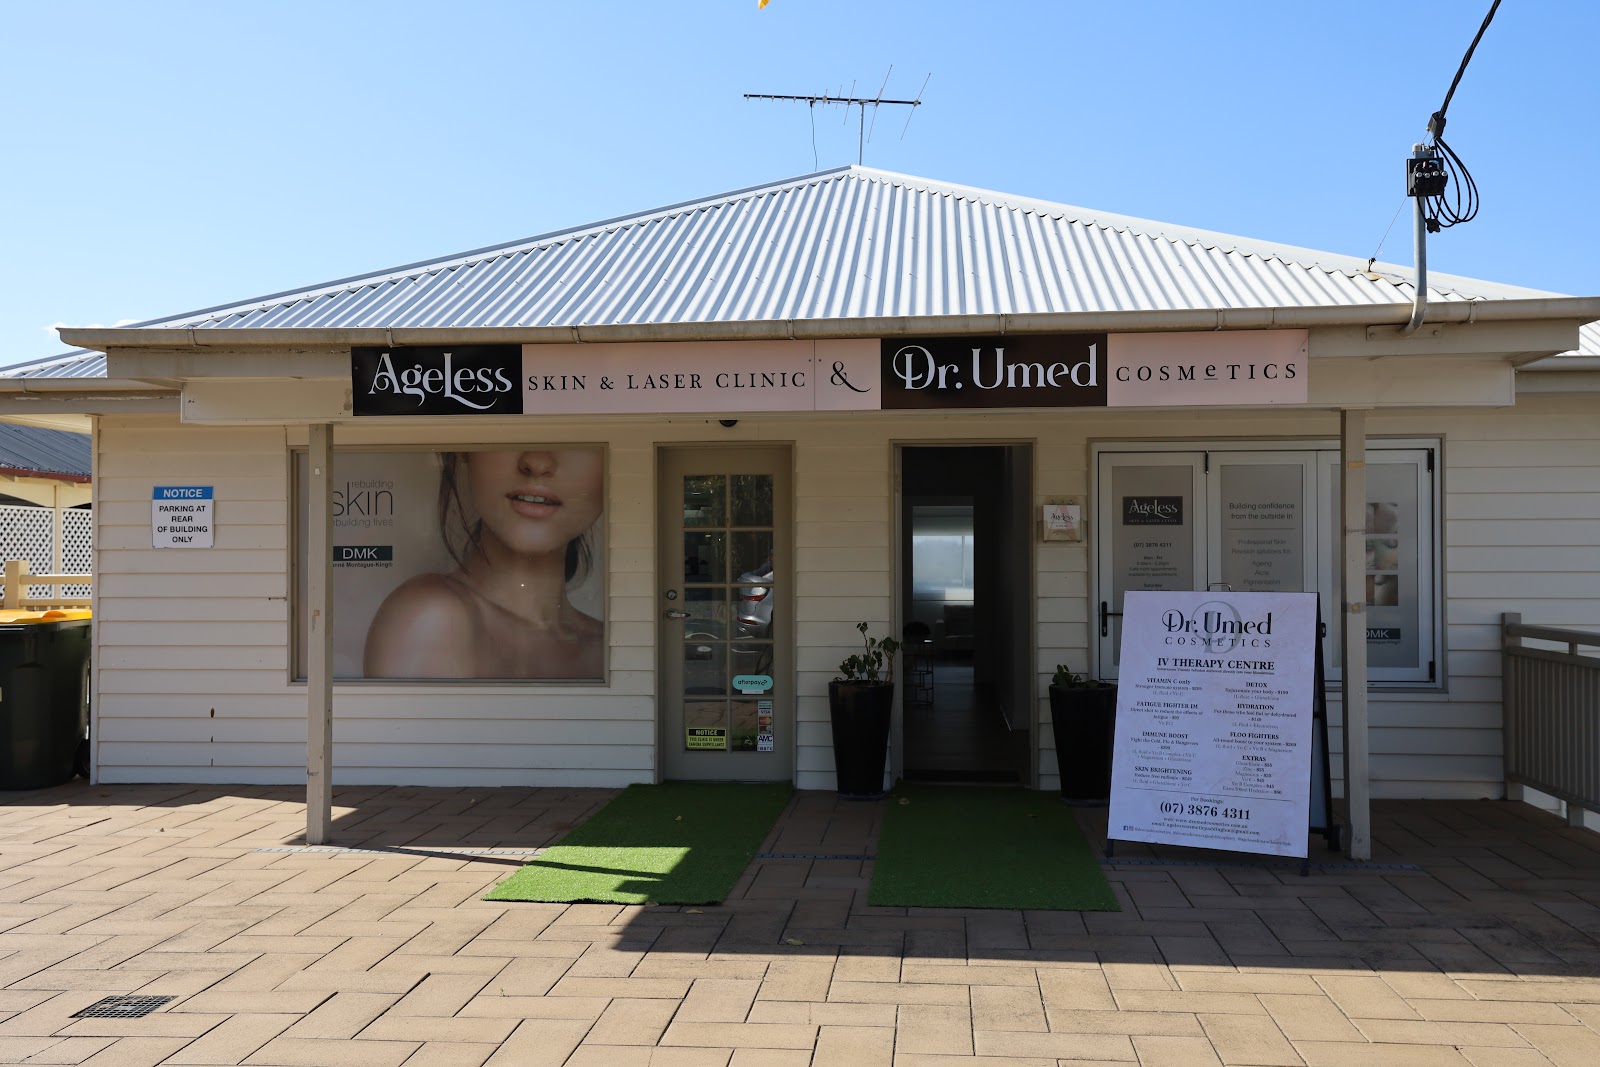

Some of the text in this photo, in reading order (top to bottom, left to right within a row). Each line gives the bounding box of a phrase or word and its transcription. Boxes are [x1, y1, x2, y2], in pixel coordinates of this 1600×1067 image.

[892, 343, 1098, 390] Dr. Umed
[528, 371, 806, 390] SKIN & LASER CLINIC
[830, 360, 871, 392] &
[352, 480, 393, 490] rebuilding
[163, 489, 203, 498] NOTICE
[374, 518, 393, 526] lives
[342, 548, 378, 559] DMK
[1162, 610, 1272, 634] Dr. Umed
[1165, 636, 1271, 647] COSMETICS
[1157, 658, 1275, 670] IV THERAPY CENTRE
[1150, 767, 1192, 775] BRIGHTENING
[1160, 800, 1250, 820] (07) 3876 4311
